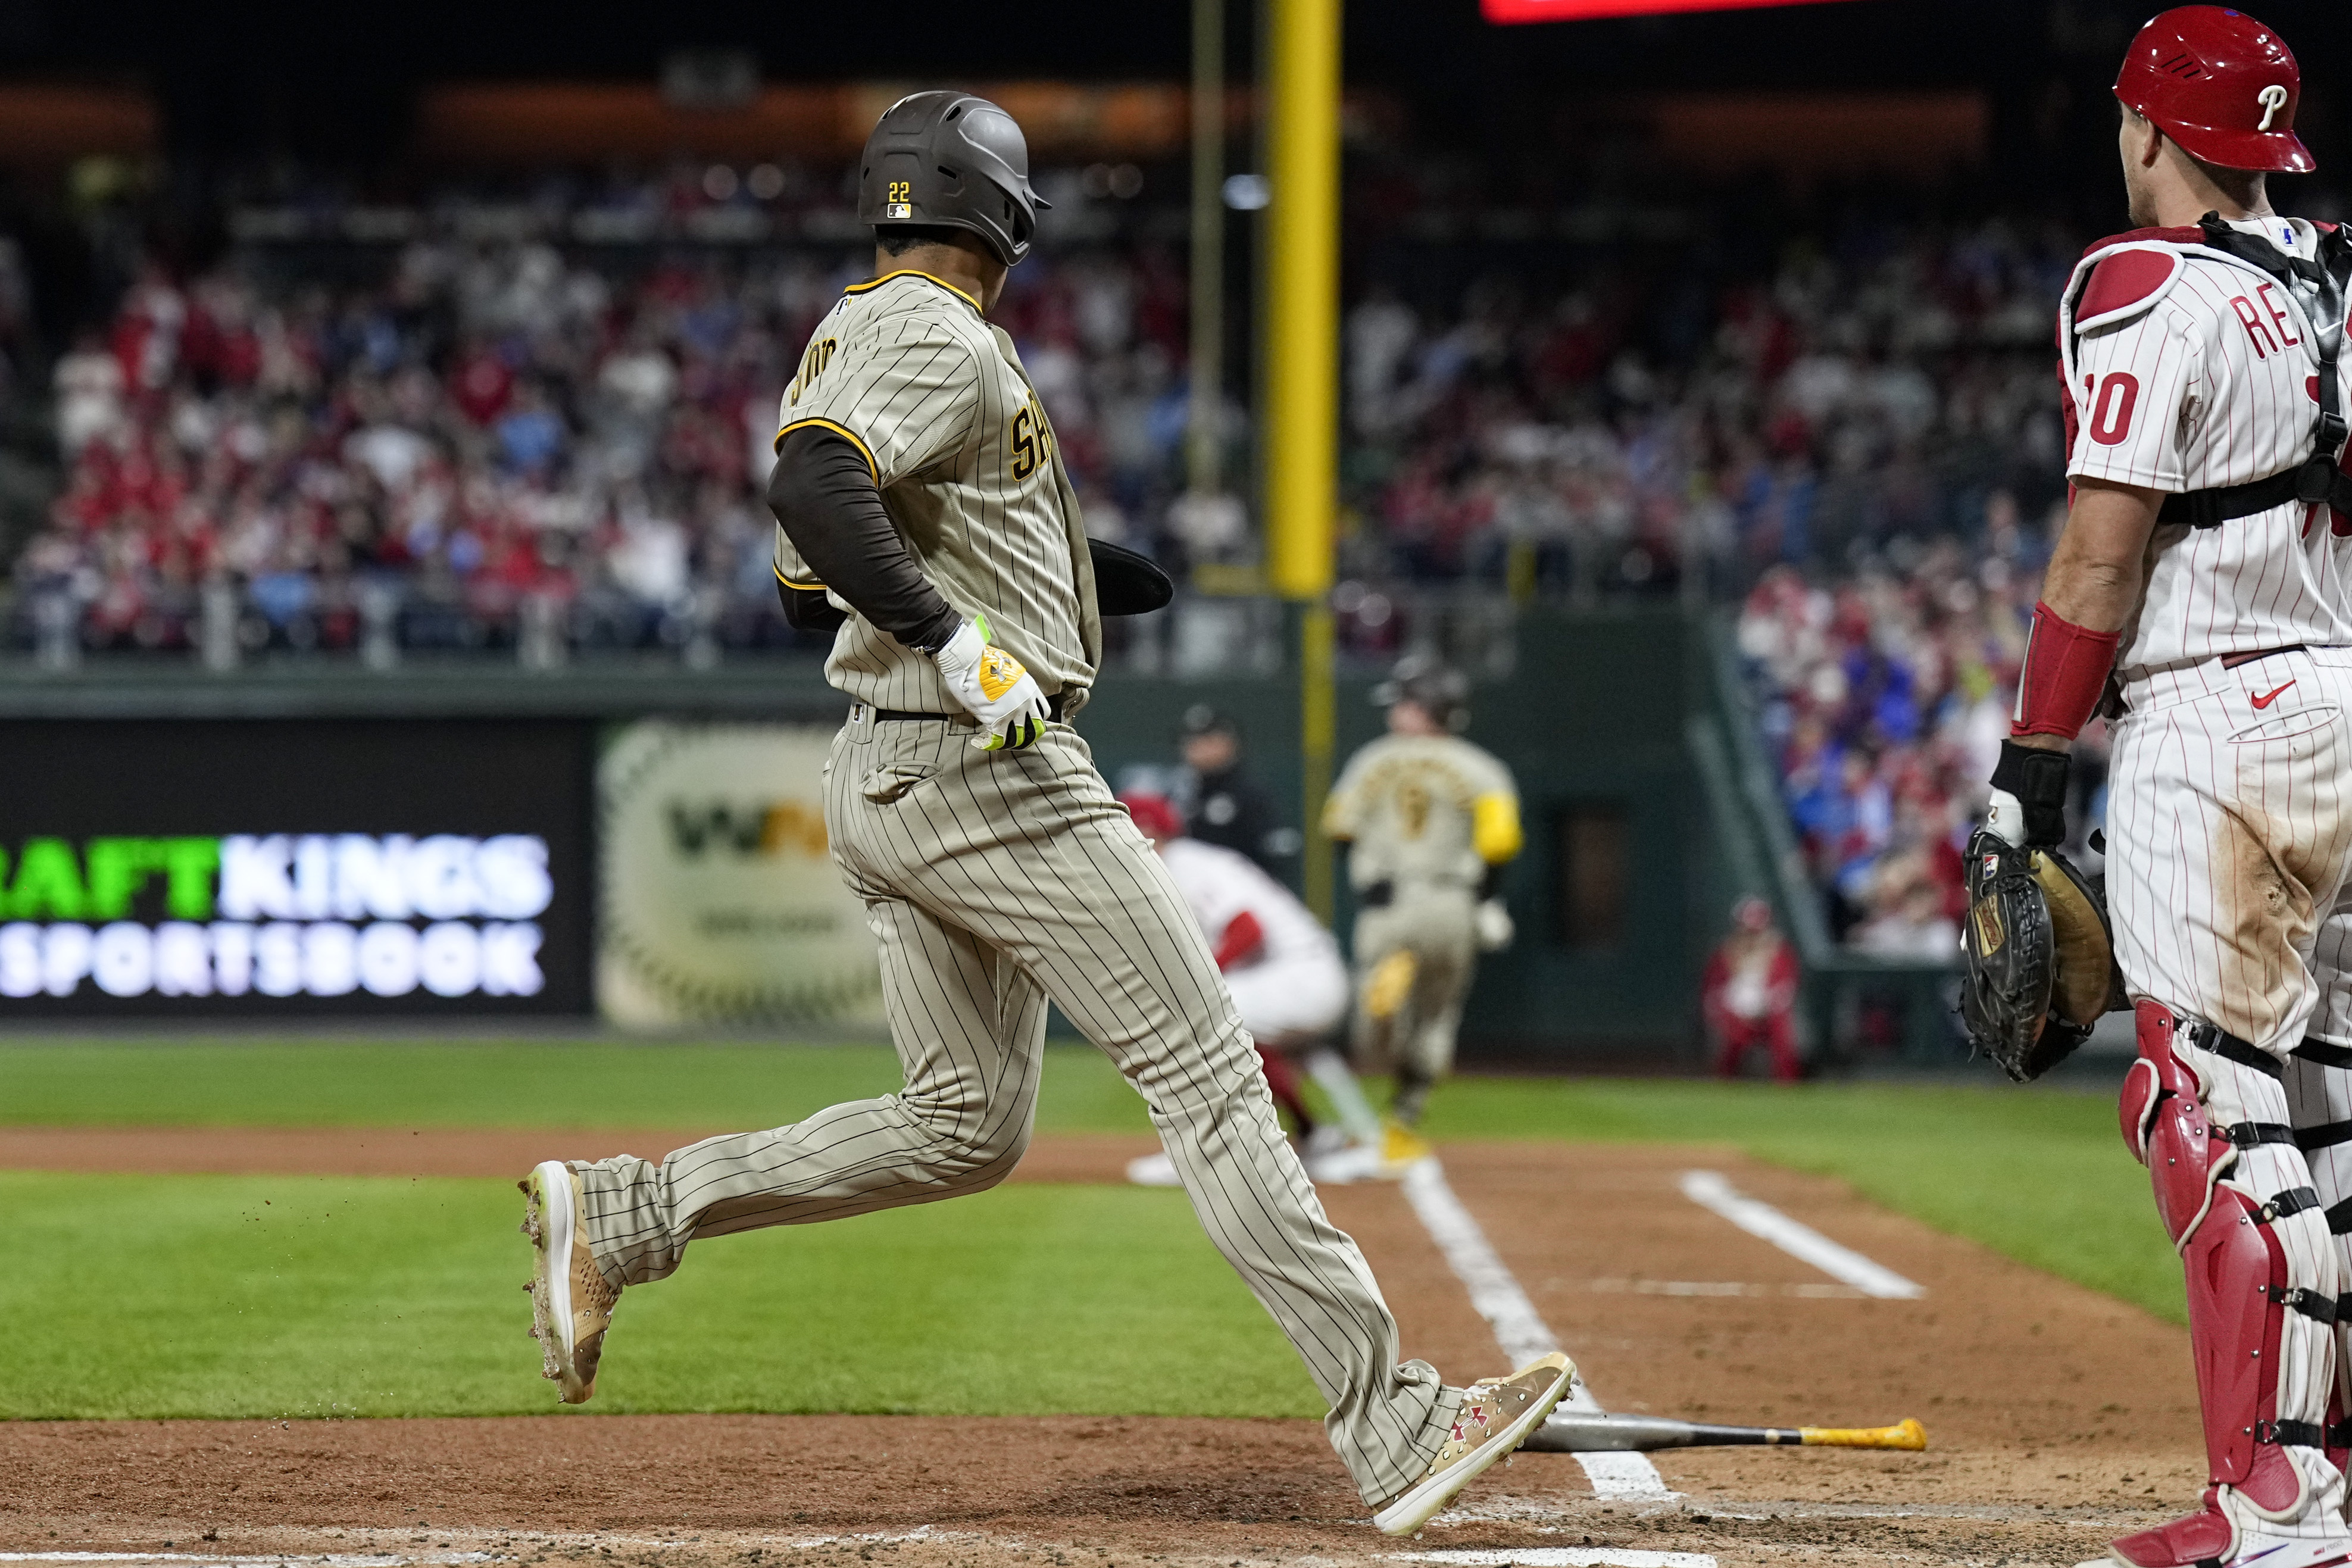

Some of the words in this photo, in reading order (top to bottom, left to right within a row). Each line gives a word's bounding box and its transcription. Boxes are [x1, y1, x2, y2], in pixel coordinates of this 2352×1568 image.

[2258, 85, 2287, 130] P
[889, 182, 909, 202] 22
[2228, 282, 2304, 359] RE
